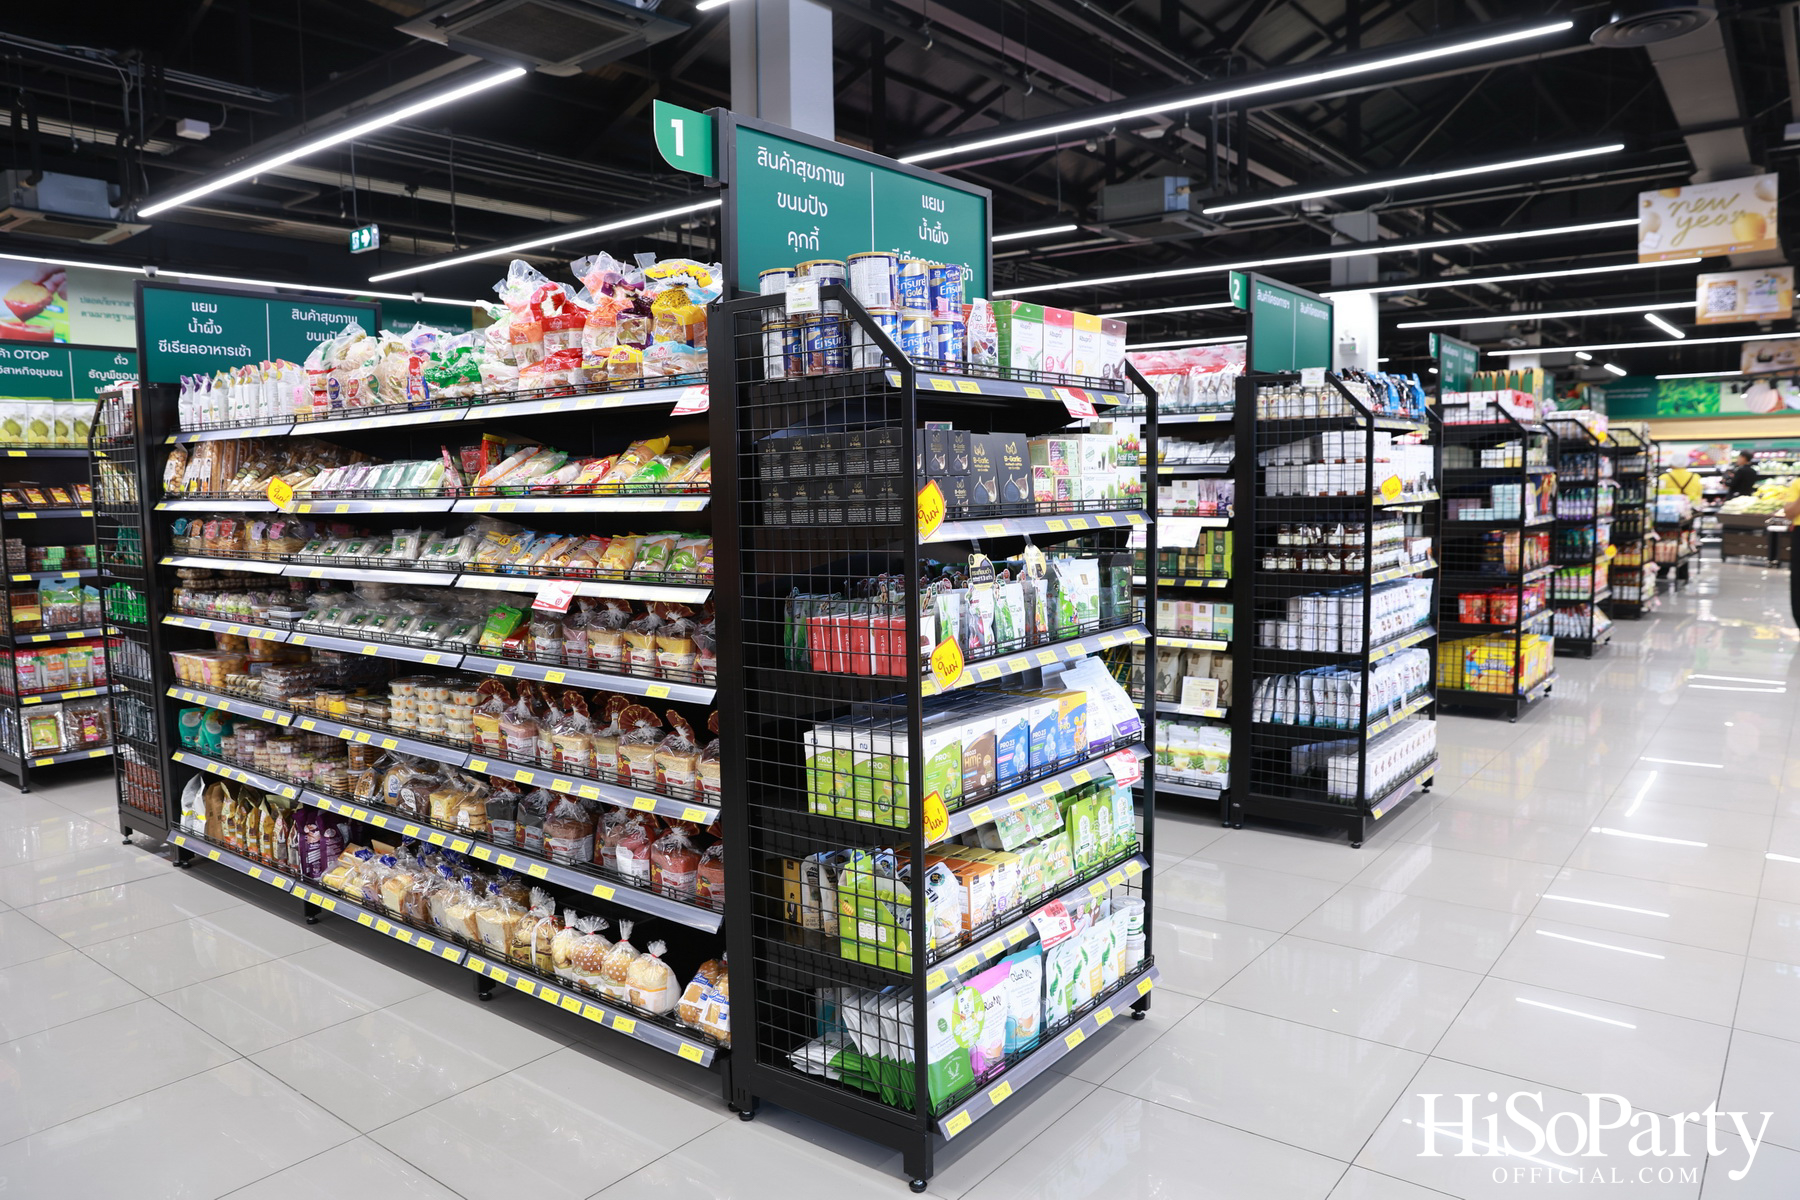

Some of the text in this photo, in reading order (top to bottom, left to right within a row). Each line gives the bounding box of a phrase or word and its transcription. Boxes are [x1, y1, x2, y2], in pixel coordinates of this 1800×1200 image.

[670, 119, 684, 157] 1
[757, 145, 845, 187] สินค้าสุขภาพ
[777, 192, 828, 218] ขนมปัง
[921, 194, 945, 213] แยม
[787, 226, 820, 254] คุกกี้
[918, 218, 949, 246] น้ำผึ้ง
[1233, 279, 1241, 301] 2
[192, 301, 218, 314] แยม
[291, 308, 358, 325] สินค้าสุขภาพ
[188, 317, 223, 335] น้ำผึ้ง
[306, 330, 339, 343] ขนมปั
[13, 349, 50, 361] OTOP
[158, 339, 252, 358] ซีเรียลอาหารเช้า
[113, 353, 129, 365] ถั่ว
